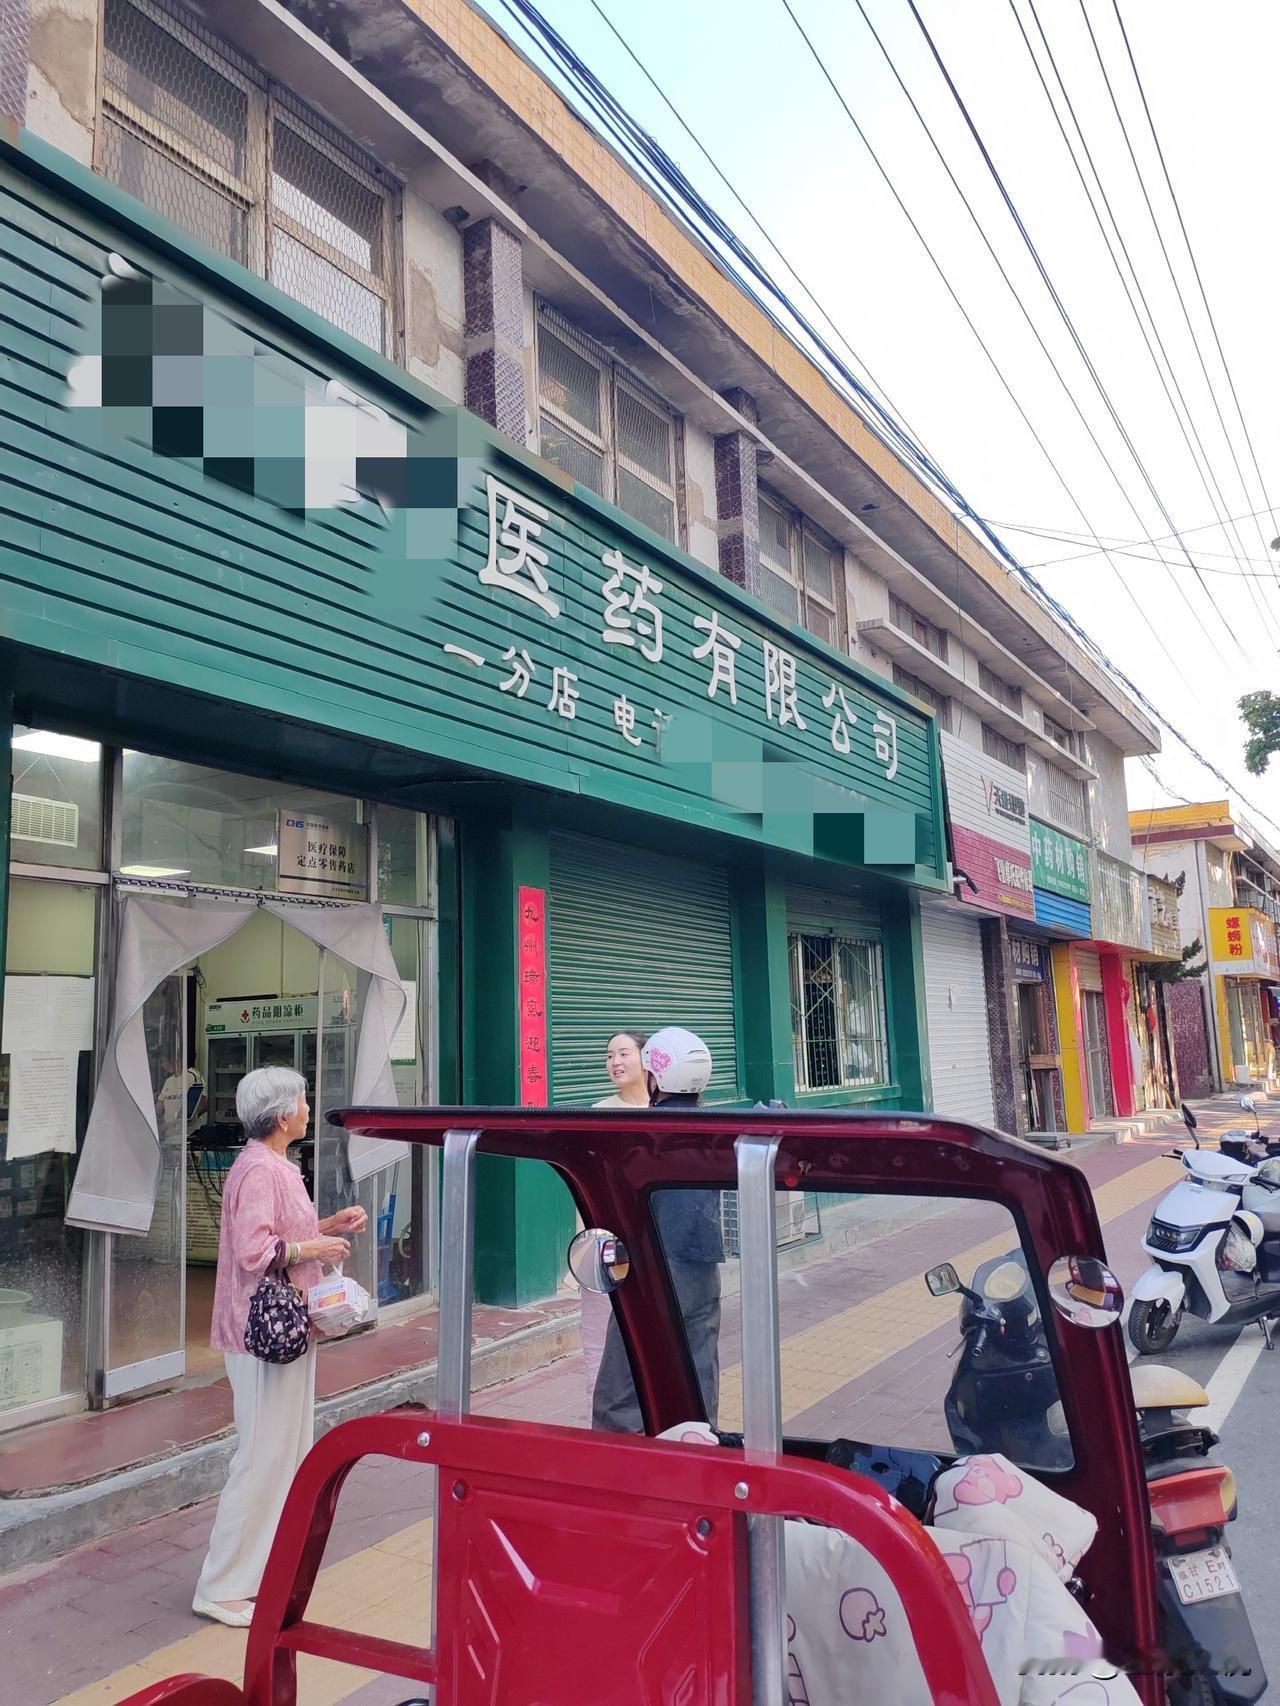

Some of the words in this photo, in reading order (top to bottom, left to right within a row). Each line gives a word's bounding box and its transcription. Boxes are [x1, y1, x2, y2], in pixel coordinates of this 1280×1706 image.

[478, 474, 900, 780] 医药有限公司
[443, 643, 580, 720] 一分店
[307, 840, 347, 859] 医疗保障
[296, 854, 355, 874] 定点零售药店
[252, 1003, 304, 1019] 药品阴凉柜
[1183, 1573, 1234, 1599] C1521
